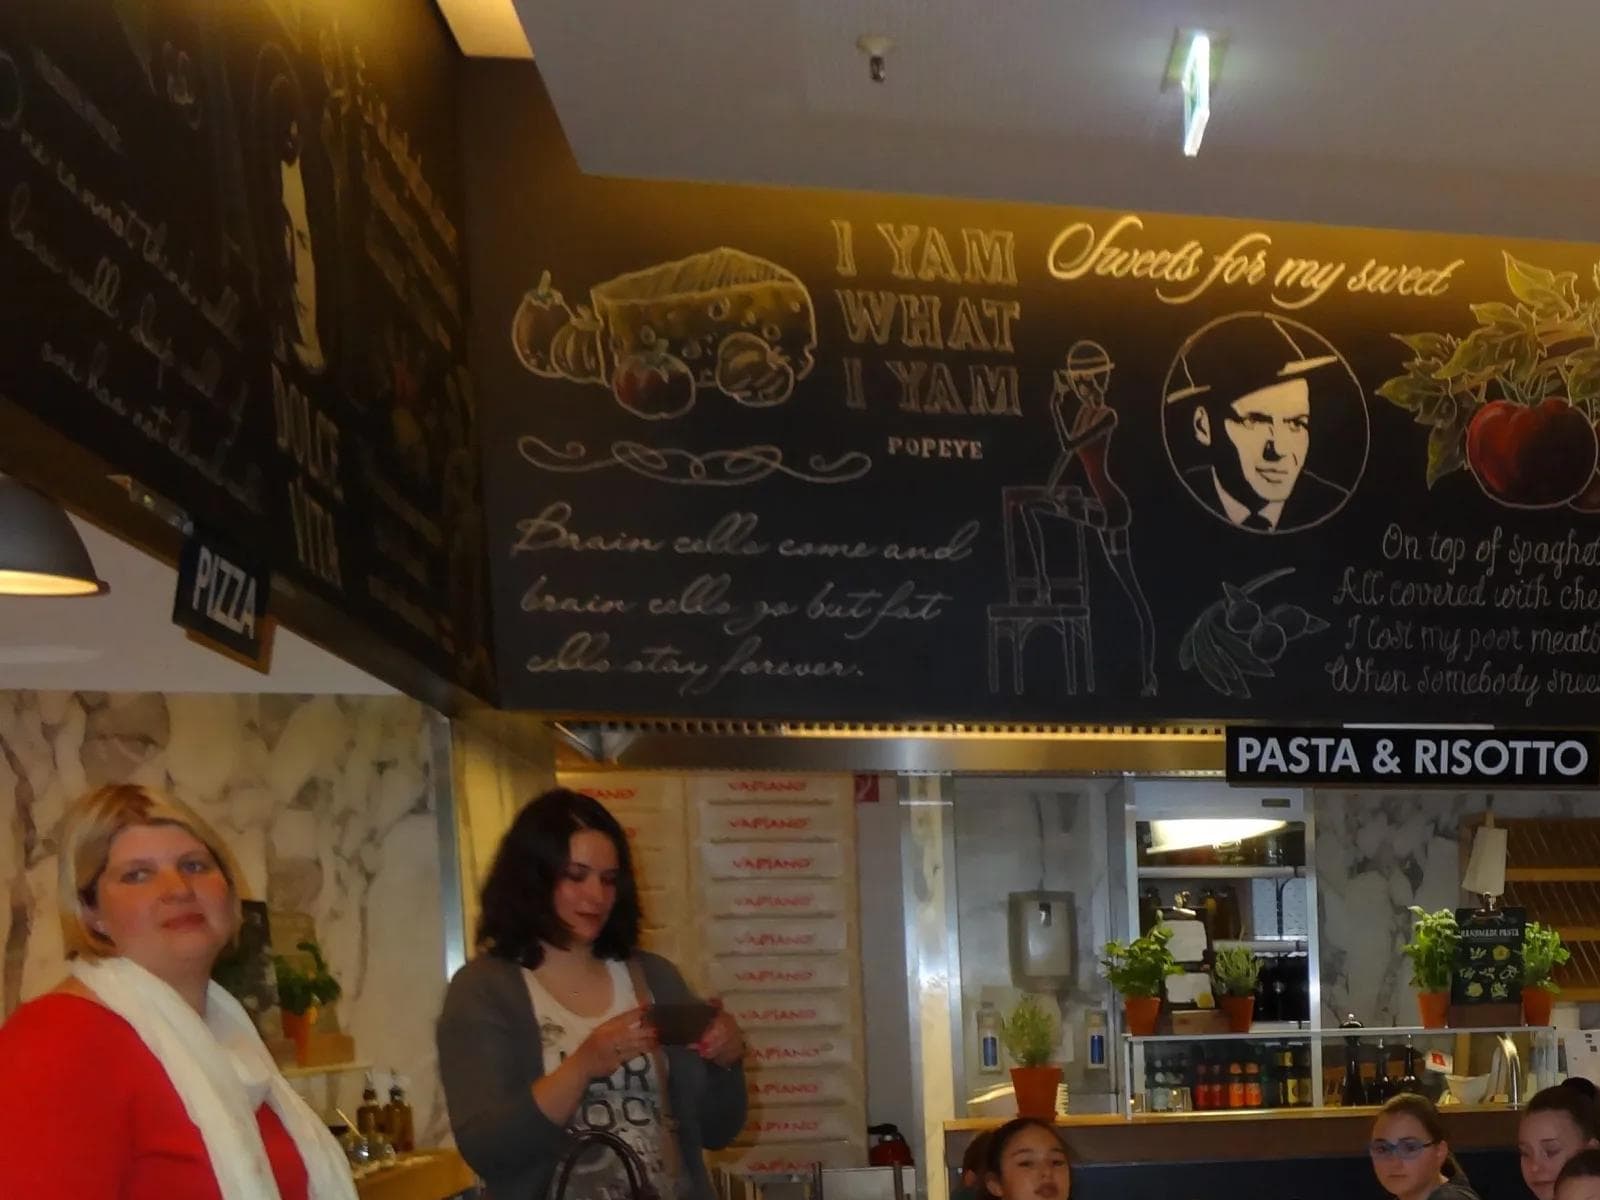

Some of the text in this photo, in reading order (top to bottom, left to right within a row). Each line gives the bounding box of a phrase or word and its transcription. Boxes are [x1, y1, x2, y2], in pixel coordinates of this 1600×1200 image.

[832, 220, 1018, 285] I YAM
[1047, 215, 1465, 309] Sweets for my sweet
[836, 290, 1021, 353] WHAT
[844, 358, 1023, 417] I YAM
[888, 435, 983, 459] POPEYE
[510, 502, 980, 561] Brain cells come and
[1382, 523, 1422, 560] On
[1429, 533, 1465, 574] top
[1475, 526, 1503, 575] of
[192, 545, 256, 639] PIZZA
[520, 575, 638, 614] brain
[807, 581, 878, 619] but
[846, 581, 953, 639] fat
[1331, 565, 1384, 607] All
[1389, 581, 1487, 609] covered
[1493, 580, 1551, 610] with
[527, 632, 864, 696] cells stay forever.
[1344, 614, 1363, 651] I
[1367, 617, 1414, 651] lost
[1421, 627, 1460, 662] my
[1469, 627, 1522, 662] poor
[1325, 656, 1410, 693] When
[1417, 662, 1541, 707] somebody
[1238, 737, 1589, 776] PASTA & RISOTTO
[1499, 928, 1520, 937] PASTA
